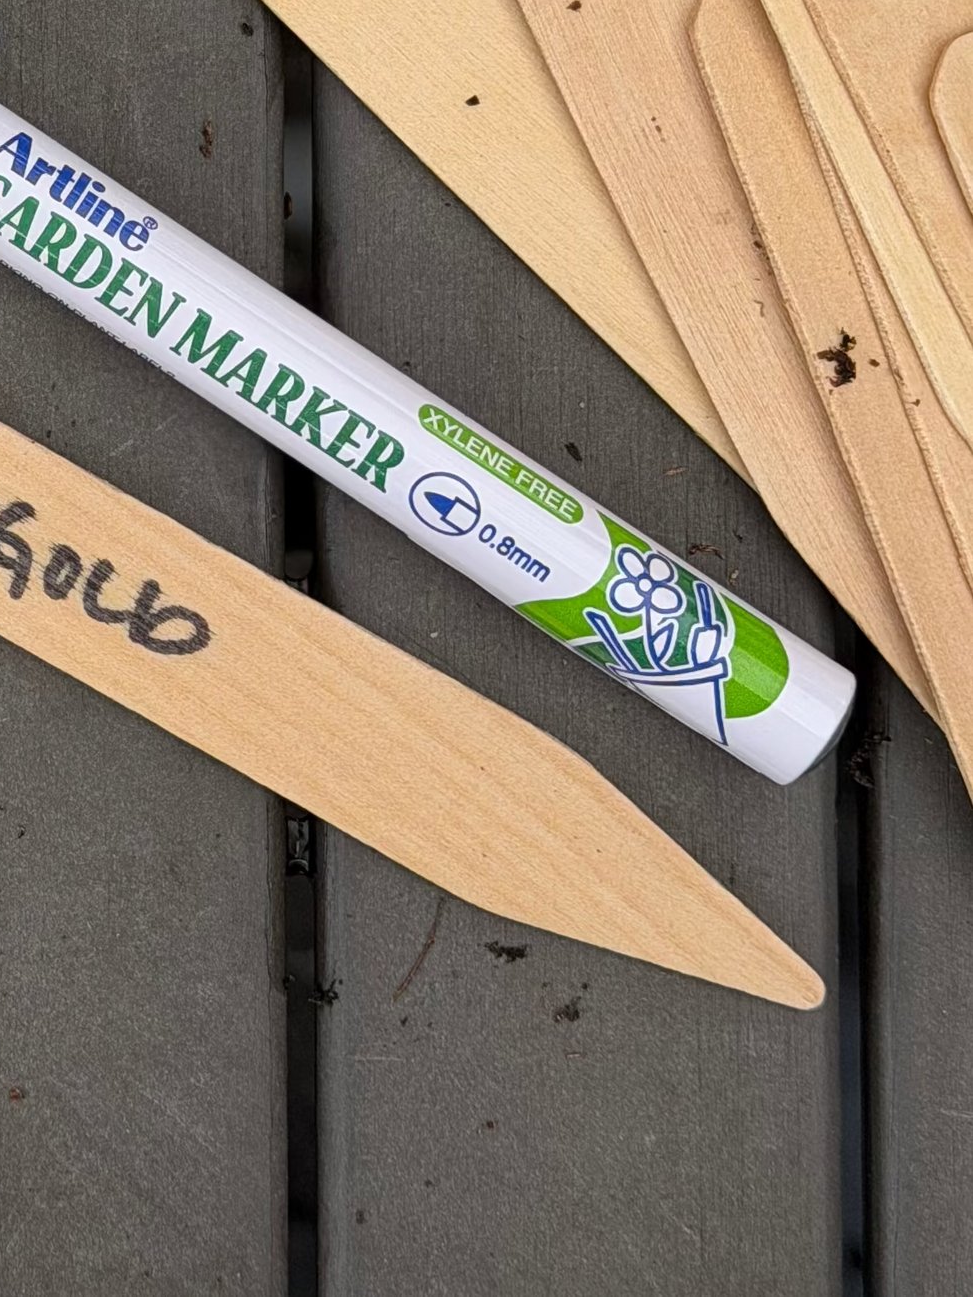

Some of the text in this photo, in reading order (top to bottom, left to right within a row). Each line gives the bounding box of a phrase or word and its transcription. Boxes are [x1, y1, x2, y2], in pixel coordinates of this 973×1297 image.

[169, 308, 405, 493] MARKER
[423, 407, 578, 521] XYLENE FREE
[478, 523, 551, 583] 0.8mm
